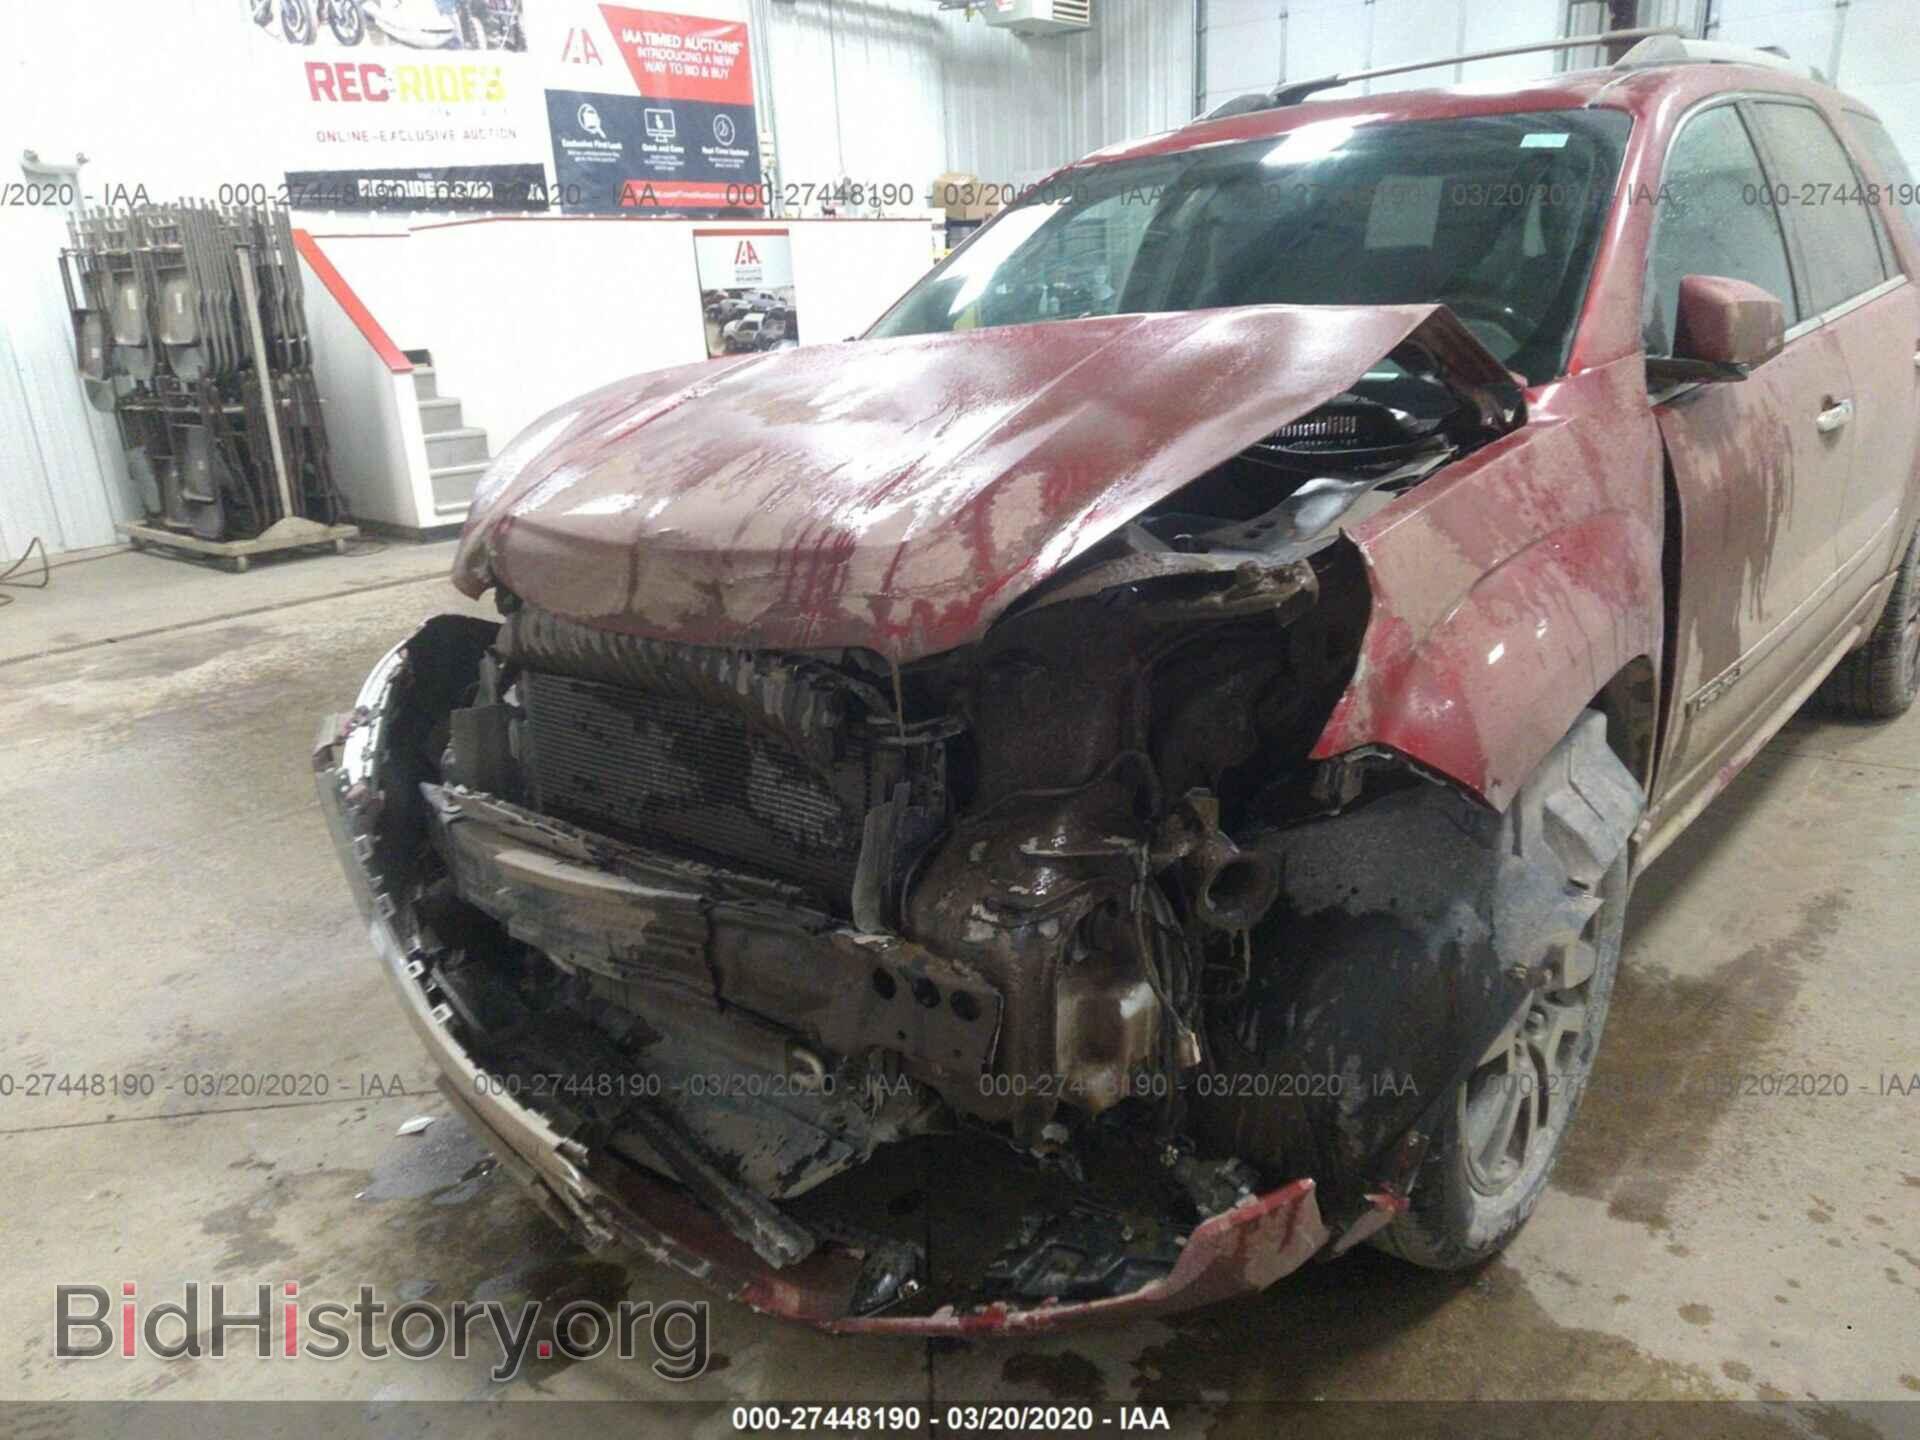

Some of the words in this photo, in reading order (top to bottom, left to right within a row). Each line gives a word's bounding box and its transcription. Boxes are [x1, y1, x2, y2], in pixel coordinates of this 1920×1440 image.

[645, 31, 682, 48] TIMED
[637, 46, 702, 64] INTRODUCING
[704, 54, 712, 65] A
[712, 54, 736, 67] NEW
[644, 61, 667, 74] WAY
[670, 63, 684, 75] TO
[684, 64, 700, 77] BID
[702, 65, 710, 77] &
[710, 66, 731, 79] BUY
[304, 61, 389, 102] REC
[396, 63, 508, 103] RIDES
[463, 127, 518, 140] AUCTION
